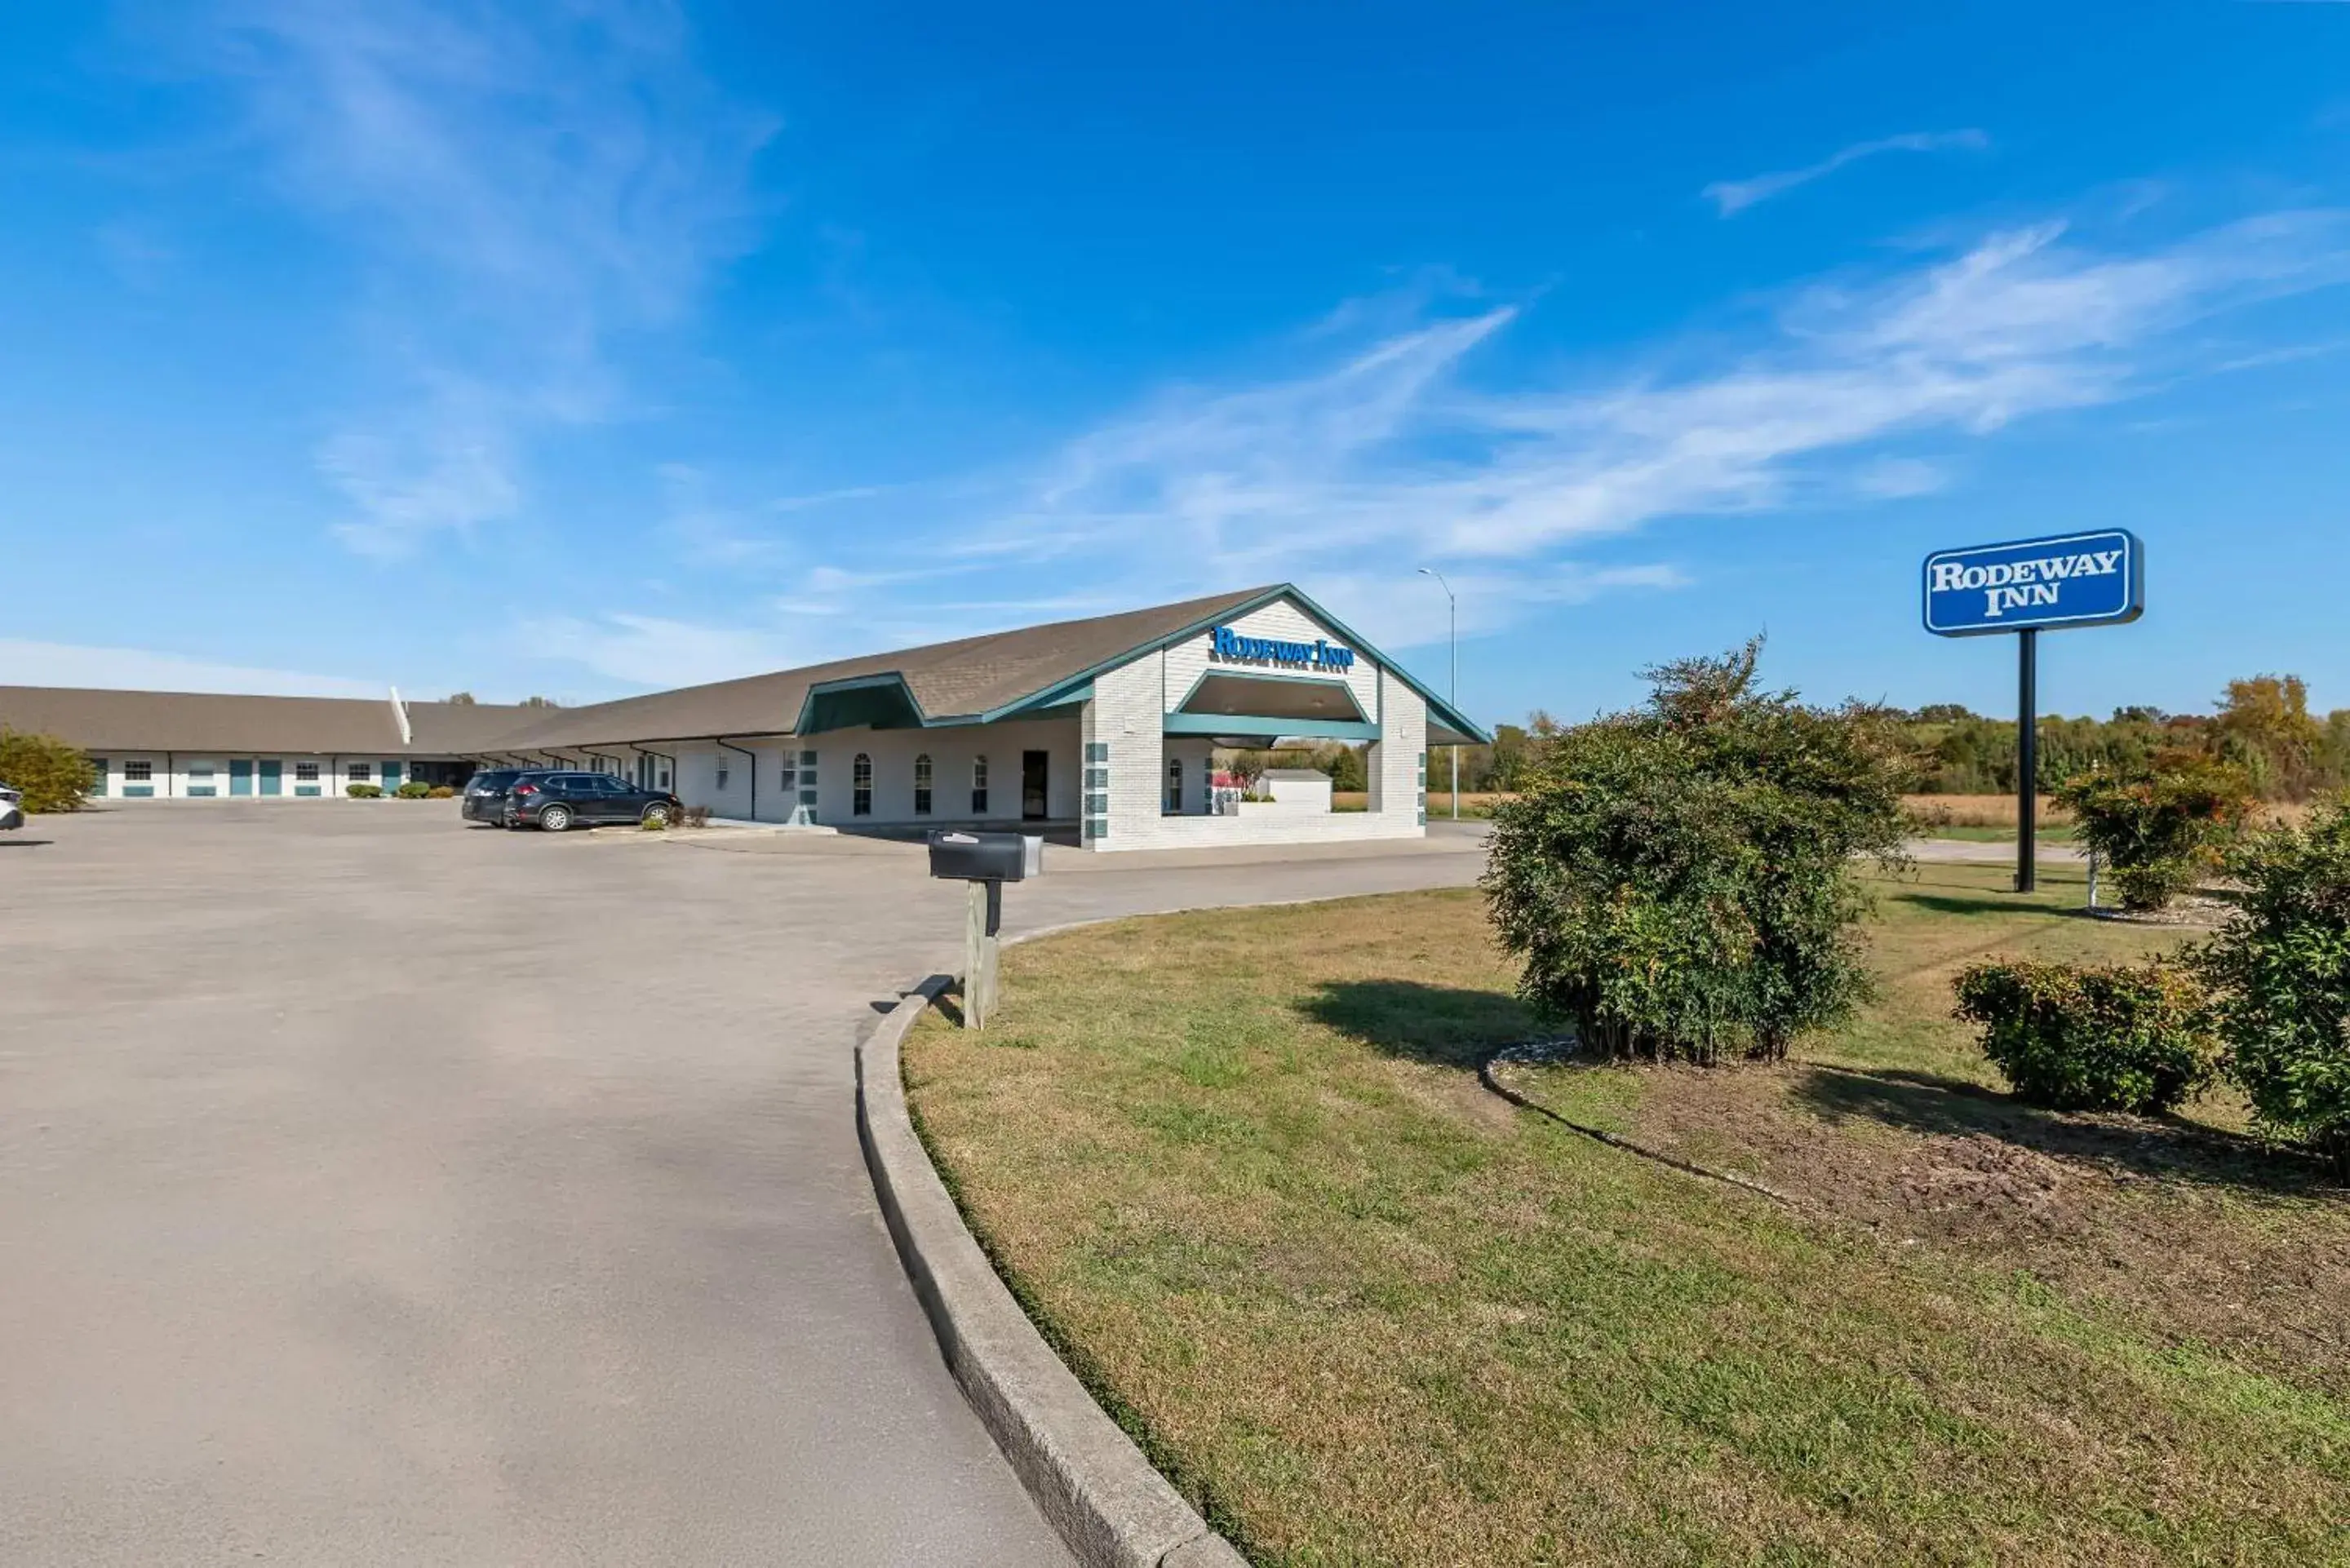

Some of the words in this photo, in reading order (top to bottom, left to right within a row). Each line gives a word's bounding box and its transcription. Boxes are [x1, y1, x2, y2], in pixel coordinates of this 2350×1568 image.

[1931, 550, 2123, 592] RODEWAY
[1984, 582, 2060, 617] INN
[1213, 626, 1315, 662] RODEWAY
[1315, 639, 1355, 666] INN
